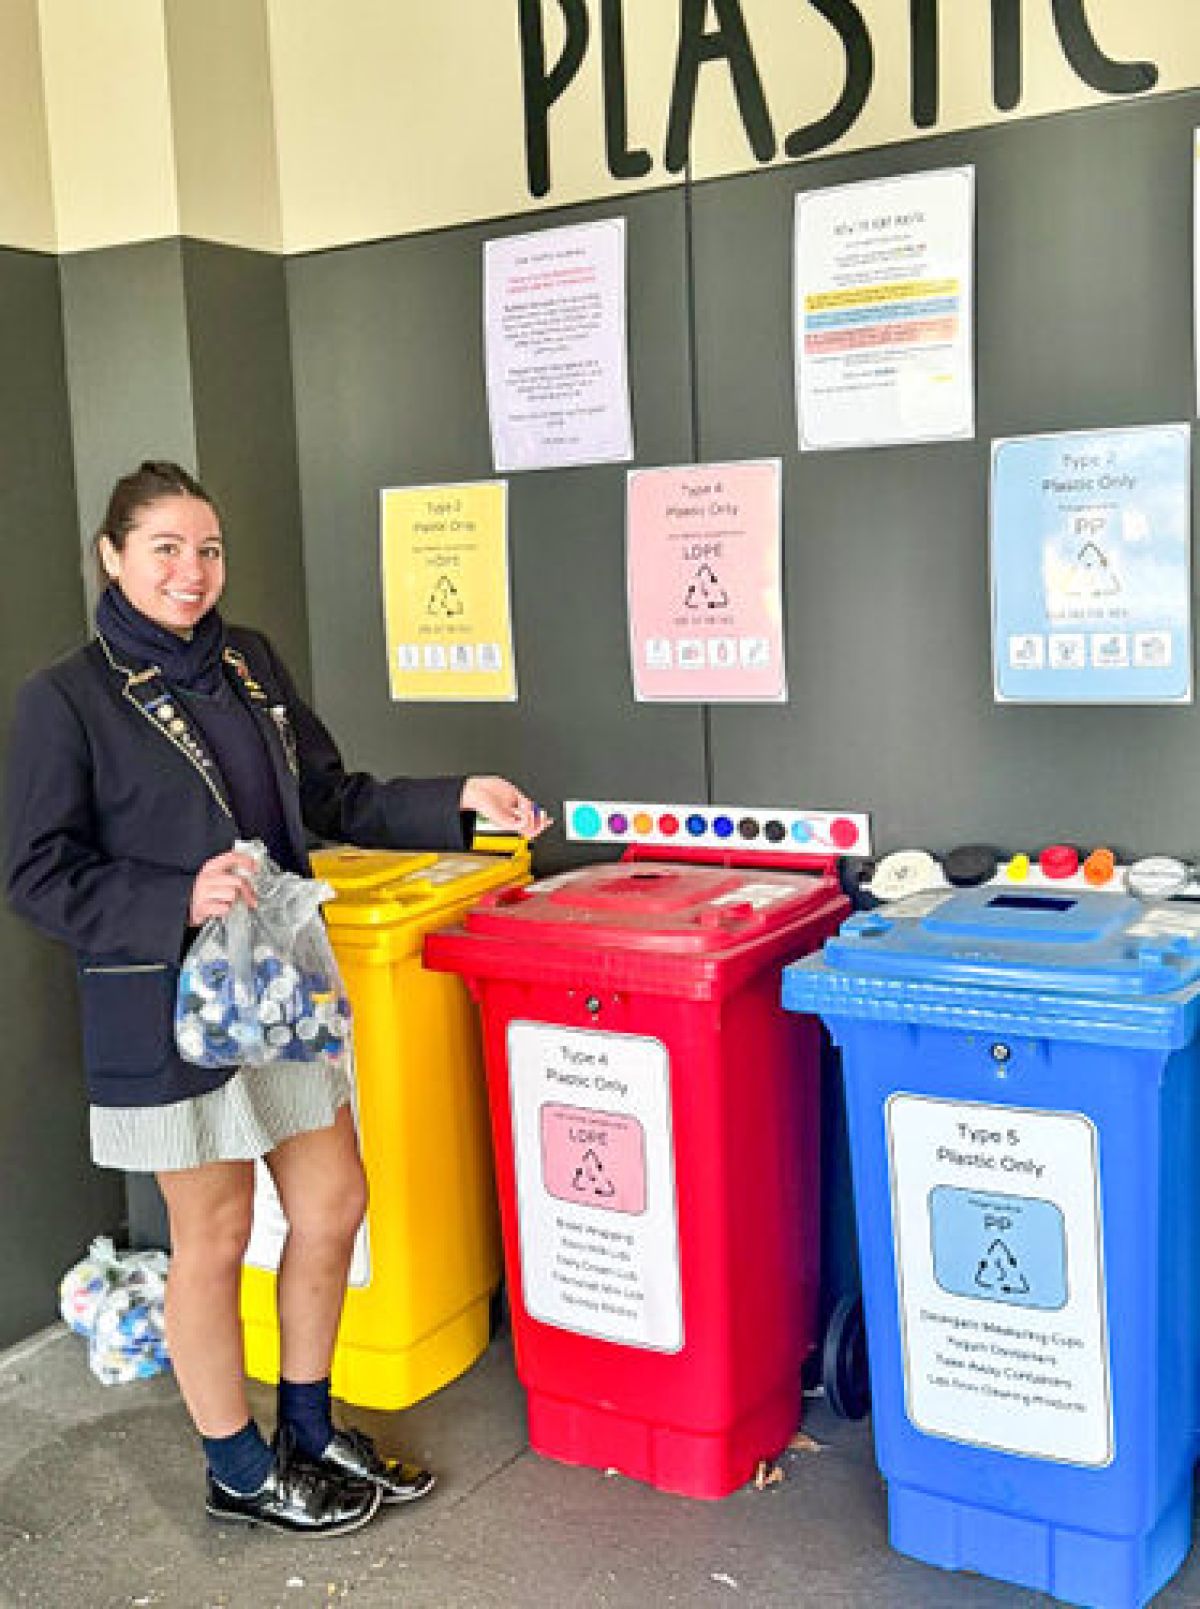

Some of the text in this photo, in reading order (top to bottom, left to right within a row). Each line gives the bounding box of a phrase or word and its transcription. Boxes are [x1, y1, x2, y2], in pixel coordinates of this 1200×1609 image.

[1041, 474, 1138, 493] Plastic Only
[682, 543, 723, 561] LDPE
[560, 1045, 595, 1066] Type
[546, 1067, 629, 1097] Plastic Only
[956, 1122, 1021, 1147] Type 5
[936, 1145, 1047, 1178] Plastic Only
[984, 1214, 1012, 1231] PP
[1004, 1367, 1072, 1390] Containers
